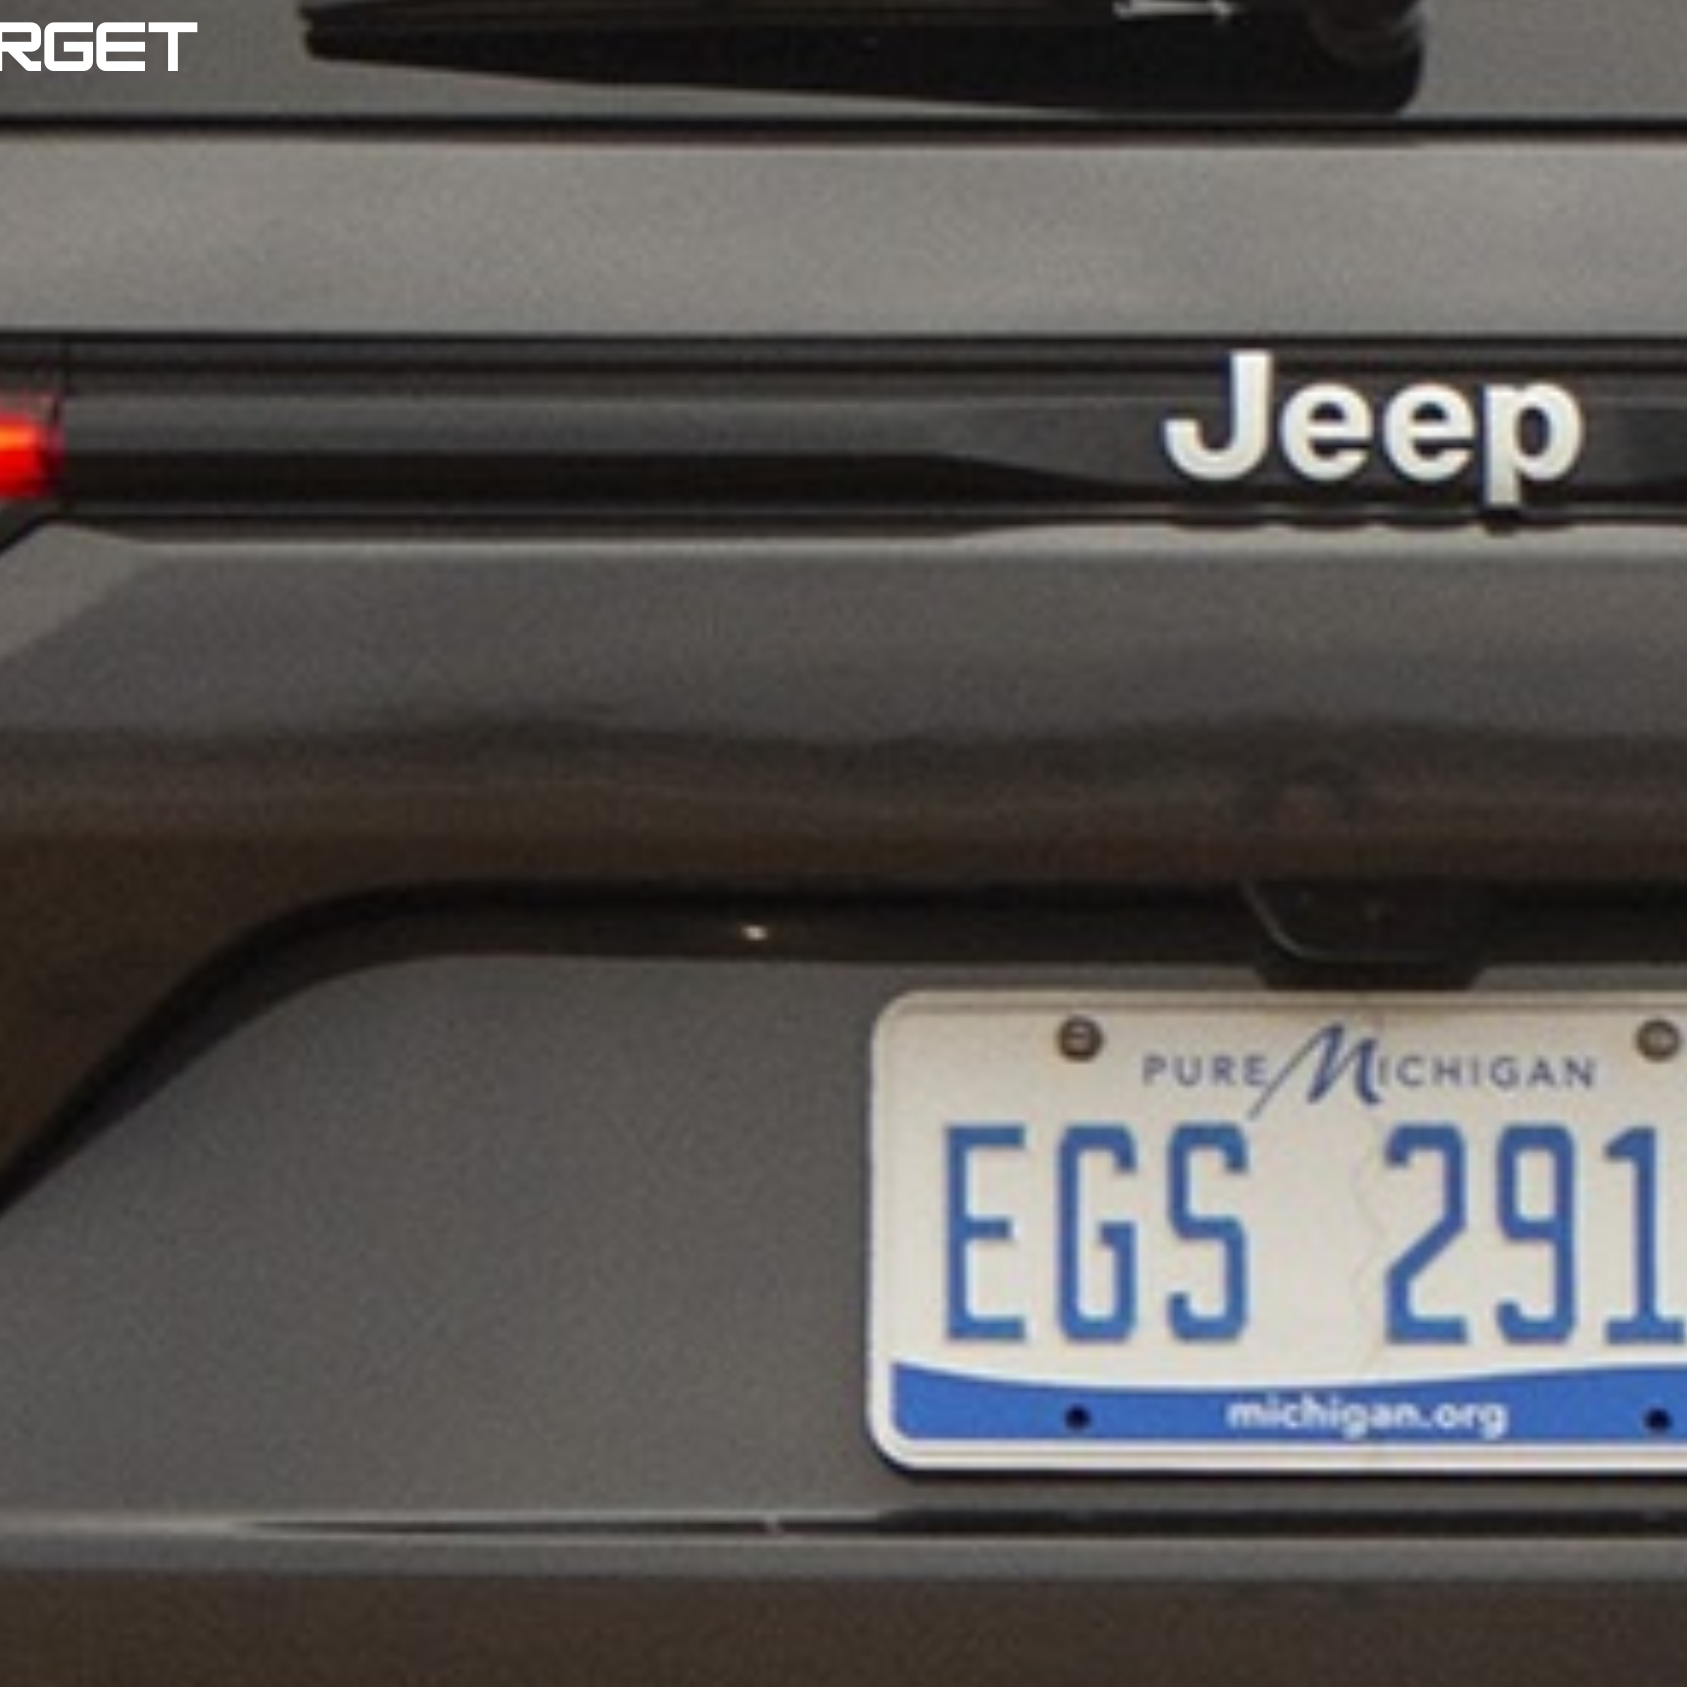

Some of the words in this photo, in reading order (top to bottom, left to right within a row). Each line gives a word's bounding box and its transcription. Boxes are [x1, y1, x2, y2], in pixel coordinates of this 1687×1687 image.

[1163, 351, 1583, 507] Jeep
[1142, 1054, 1269, 1087] PURE
[1248, 1022, 1595, 1119] MICHIGAN
[944, 1124, 1250, 1342] EGS
[1384, 1124, 1686, 1344] 291
[1226, 1394, 1508, 1436] michigan.org
